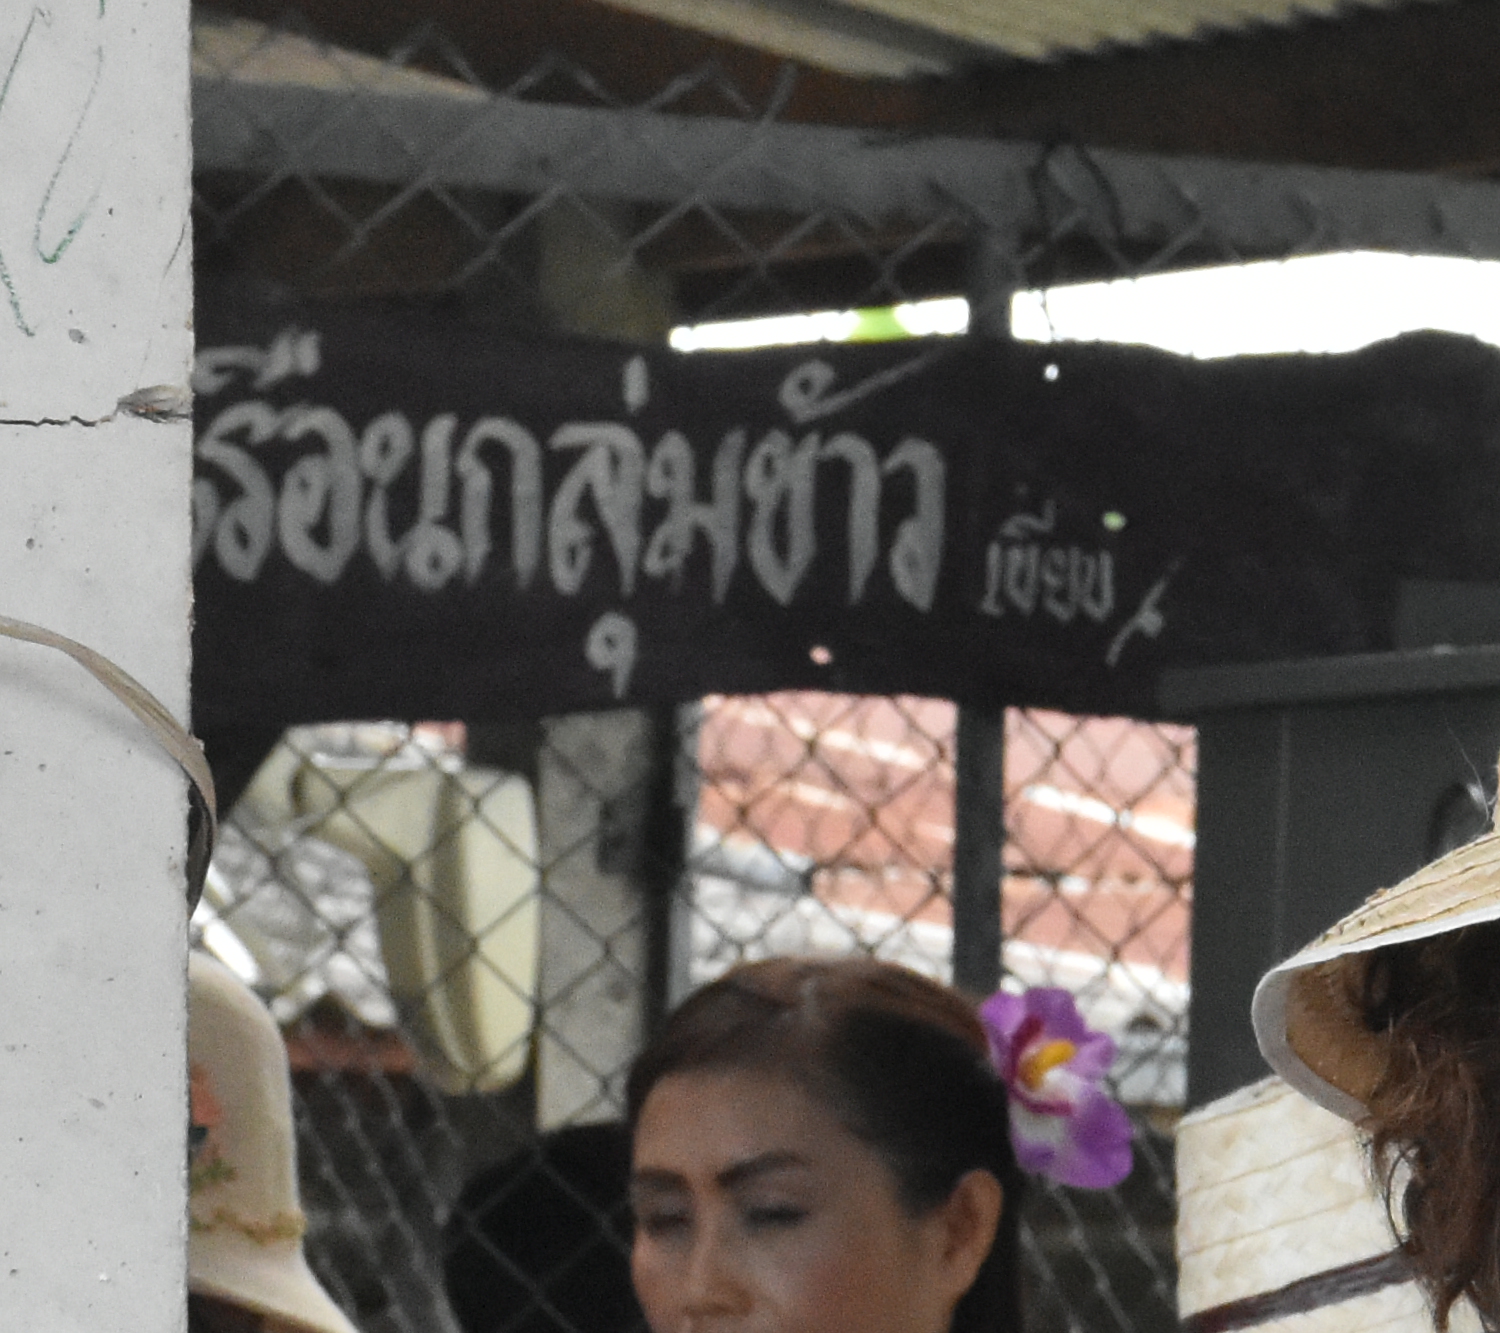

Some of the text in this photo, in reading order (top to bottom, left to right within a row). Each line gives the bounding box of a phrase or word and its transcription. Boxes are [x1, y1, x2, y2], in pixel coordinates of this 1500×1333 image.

[192, 328, 948, 698] รือนกลุ่มข้าว
